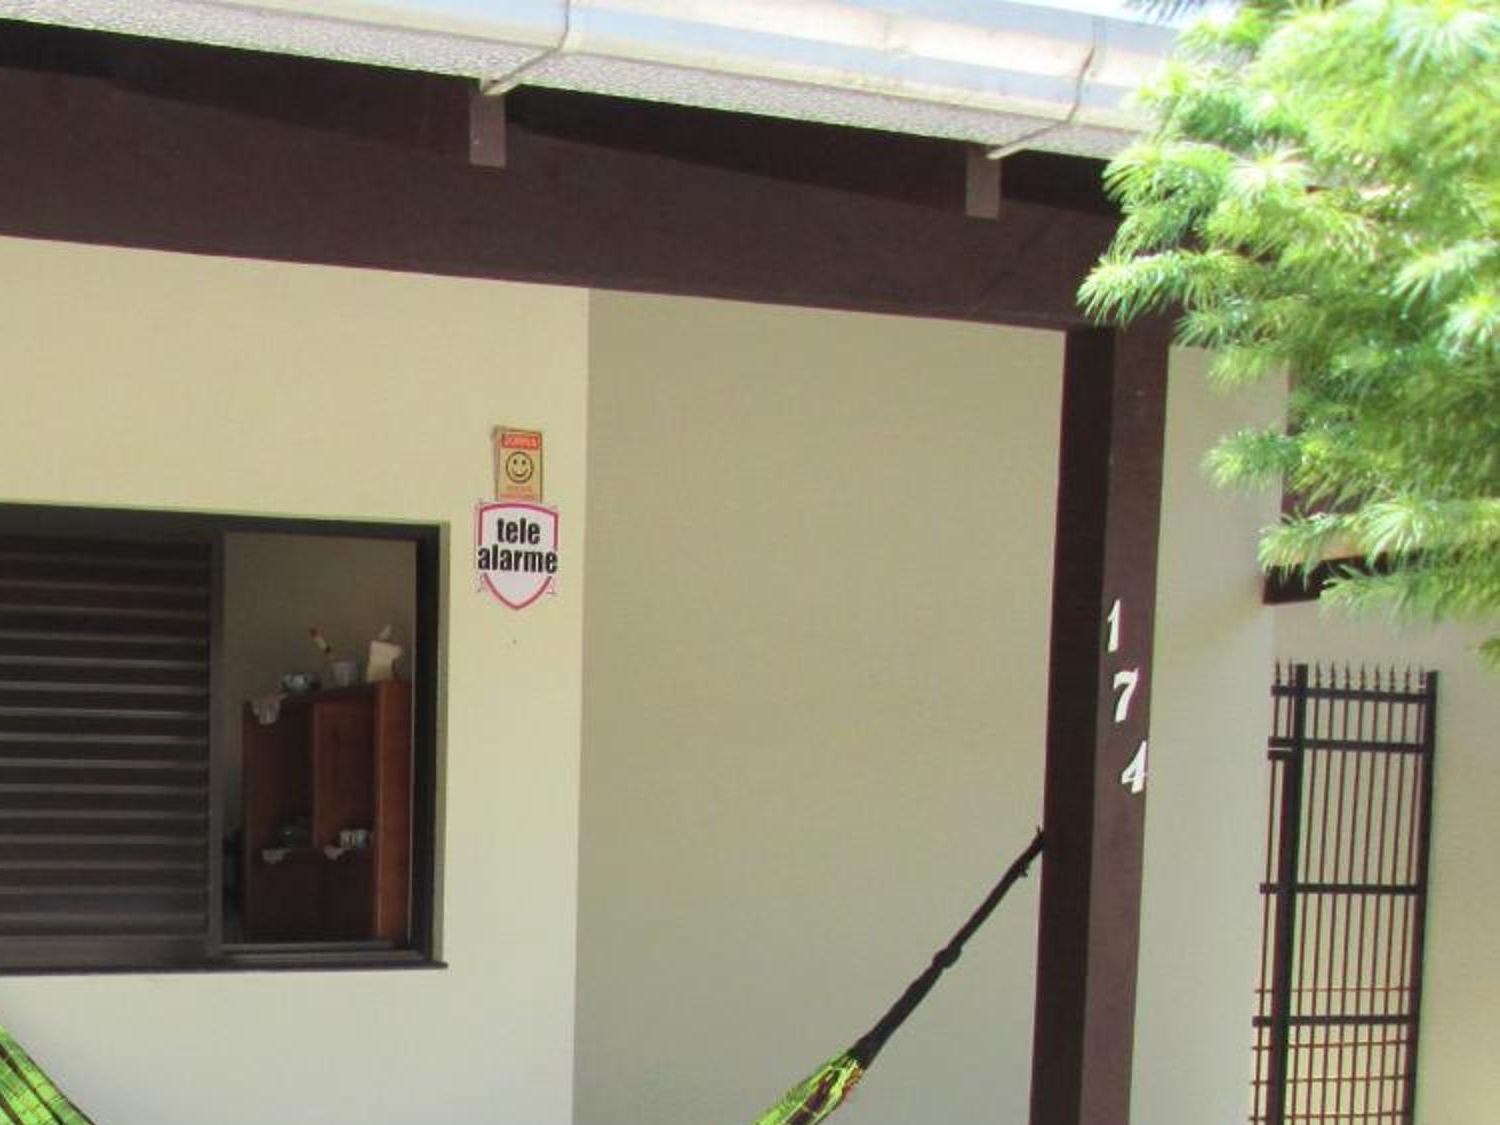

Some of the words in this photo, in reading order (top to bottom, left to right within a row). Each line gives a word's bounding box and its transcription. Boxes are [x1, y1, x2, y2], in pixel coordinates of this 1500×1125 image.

[497, 518, 541, 545] tele
[478, 544, 558, 573] alarme
[1107, 598, 1148, 794] 174
